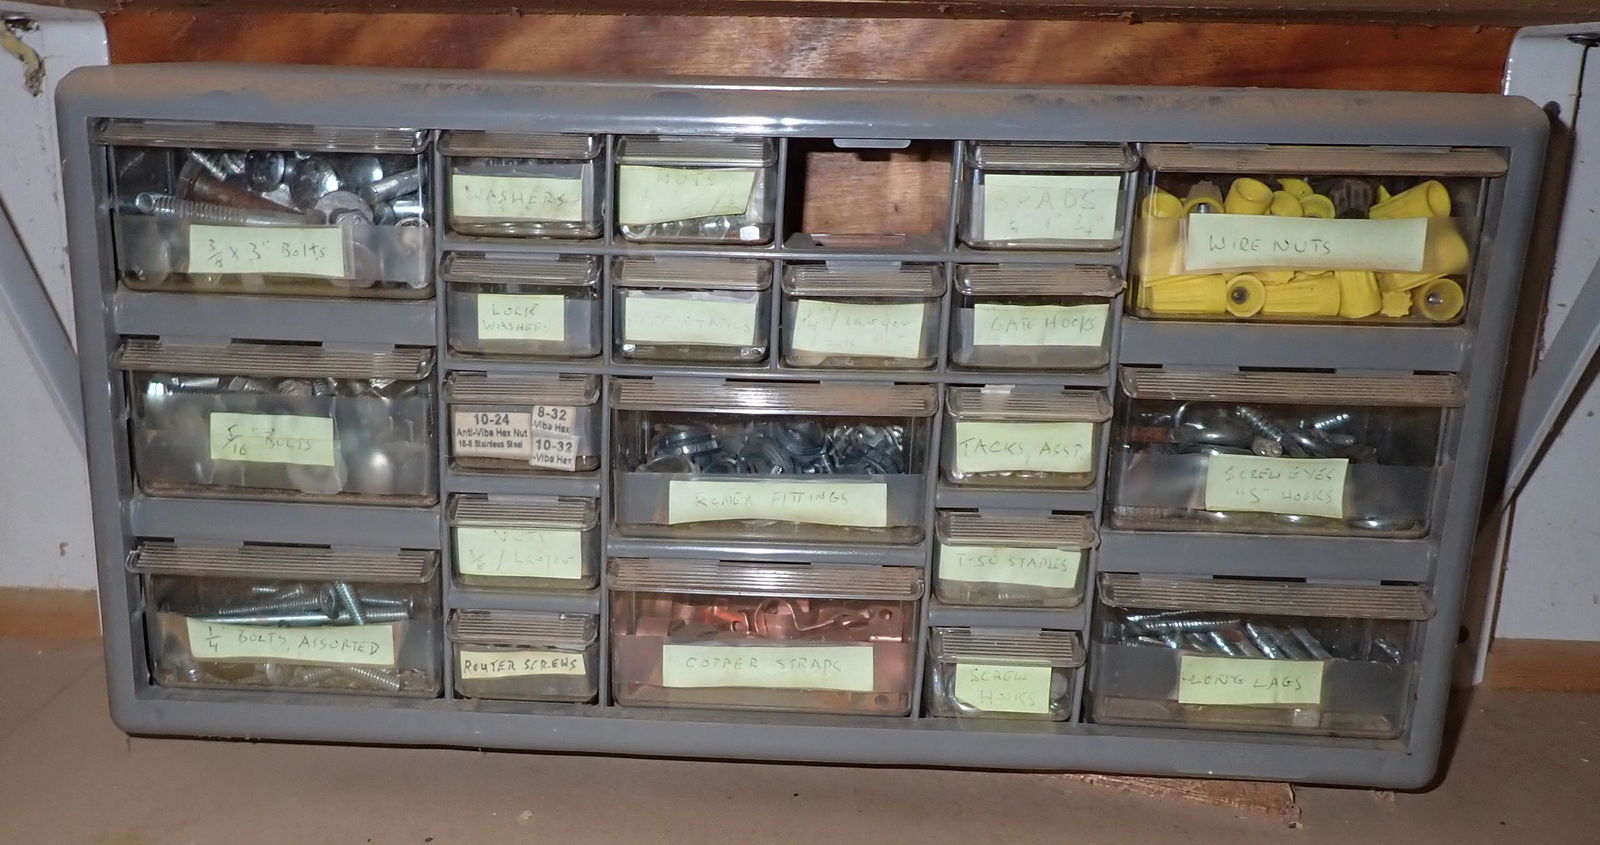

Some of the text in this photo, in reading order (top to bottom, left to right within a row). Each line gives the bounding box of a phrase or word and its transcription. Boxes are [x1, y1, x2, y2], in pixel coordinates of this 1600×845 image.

[656, 172, 715, 187] NUTS
[464, 184, 568, 208] WASHERS
[1209, 234, 1333, 255] WIRE NUTS
[491, 303, 540, 318] LOCK
[1045, 314, 1097, 334] HOOKS
[473, 413, 511, 425] 10-24
[537, 406, 567, 421] 8-32
[456, 428, 528, 438] Anti-Vibe Hex Nut
[554, 423, 570, 434] Hex
[474, 439, 504, 449] Stainless
[506, 440, 523, 449] Steel
[536, 438, 573, 452] 10-32
[556, 454, 573, 464] Hex
[1224, 465, 1281, 482] SCREW
[771, 490, 850, 507] FITTINGS
[1282, 487, 1333, 504] HOOKS
[954, 552, 1068, 572] T-50 STAPLES
[297, 634, 380, 655] ASSORTED
[463, 656, 577, 674] ROUTER SCREWS
[686, 656, 842, 673] COPPER STRAPS
[970, 667, 1027, 682] SCREW
[1253, 675, 1303, 691] LAGS
